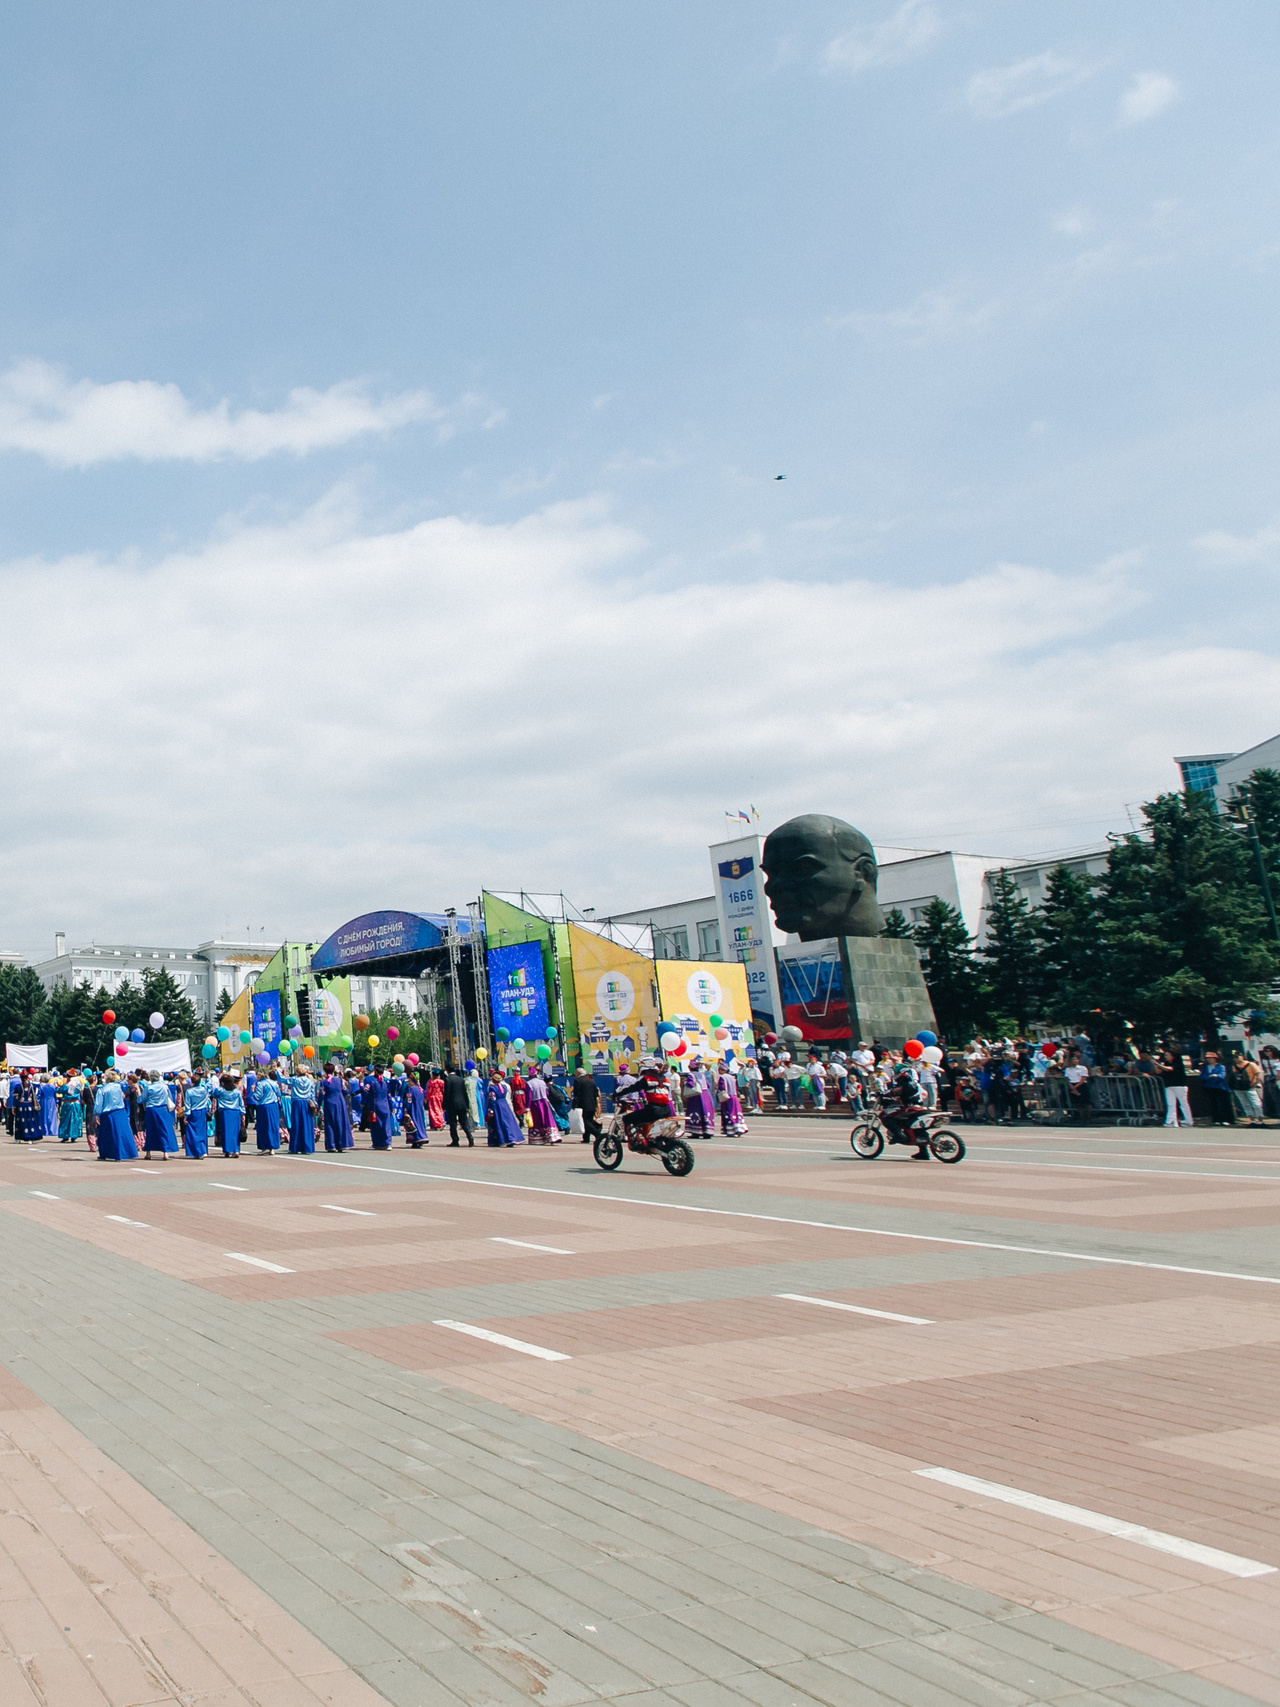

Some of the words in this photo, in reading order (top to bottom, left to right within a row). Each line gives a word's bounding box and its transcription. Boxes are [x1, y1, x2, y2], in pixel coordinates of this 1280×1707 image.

[728, 889, 754, 903] 1666
[337, 936, 343, 945] С
[343, 932, 362, 945] ДНЁМ
[363, 921, 405, 940] РОЖДЕНИЯ,
[340, 940, 375, 958] ЛЮБИМЫЙ
[375, 936, 403, 950] ГОРОД!
[728, 939, 763, 949] УЛАН-УДЭ
[746, 971, 766, 984] 022
[501, 986, 535, 998] УЛАН-УДЭ
